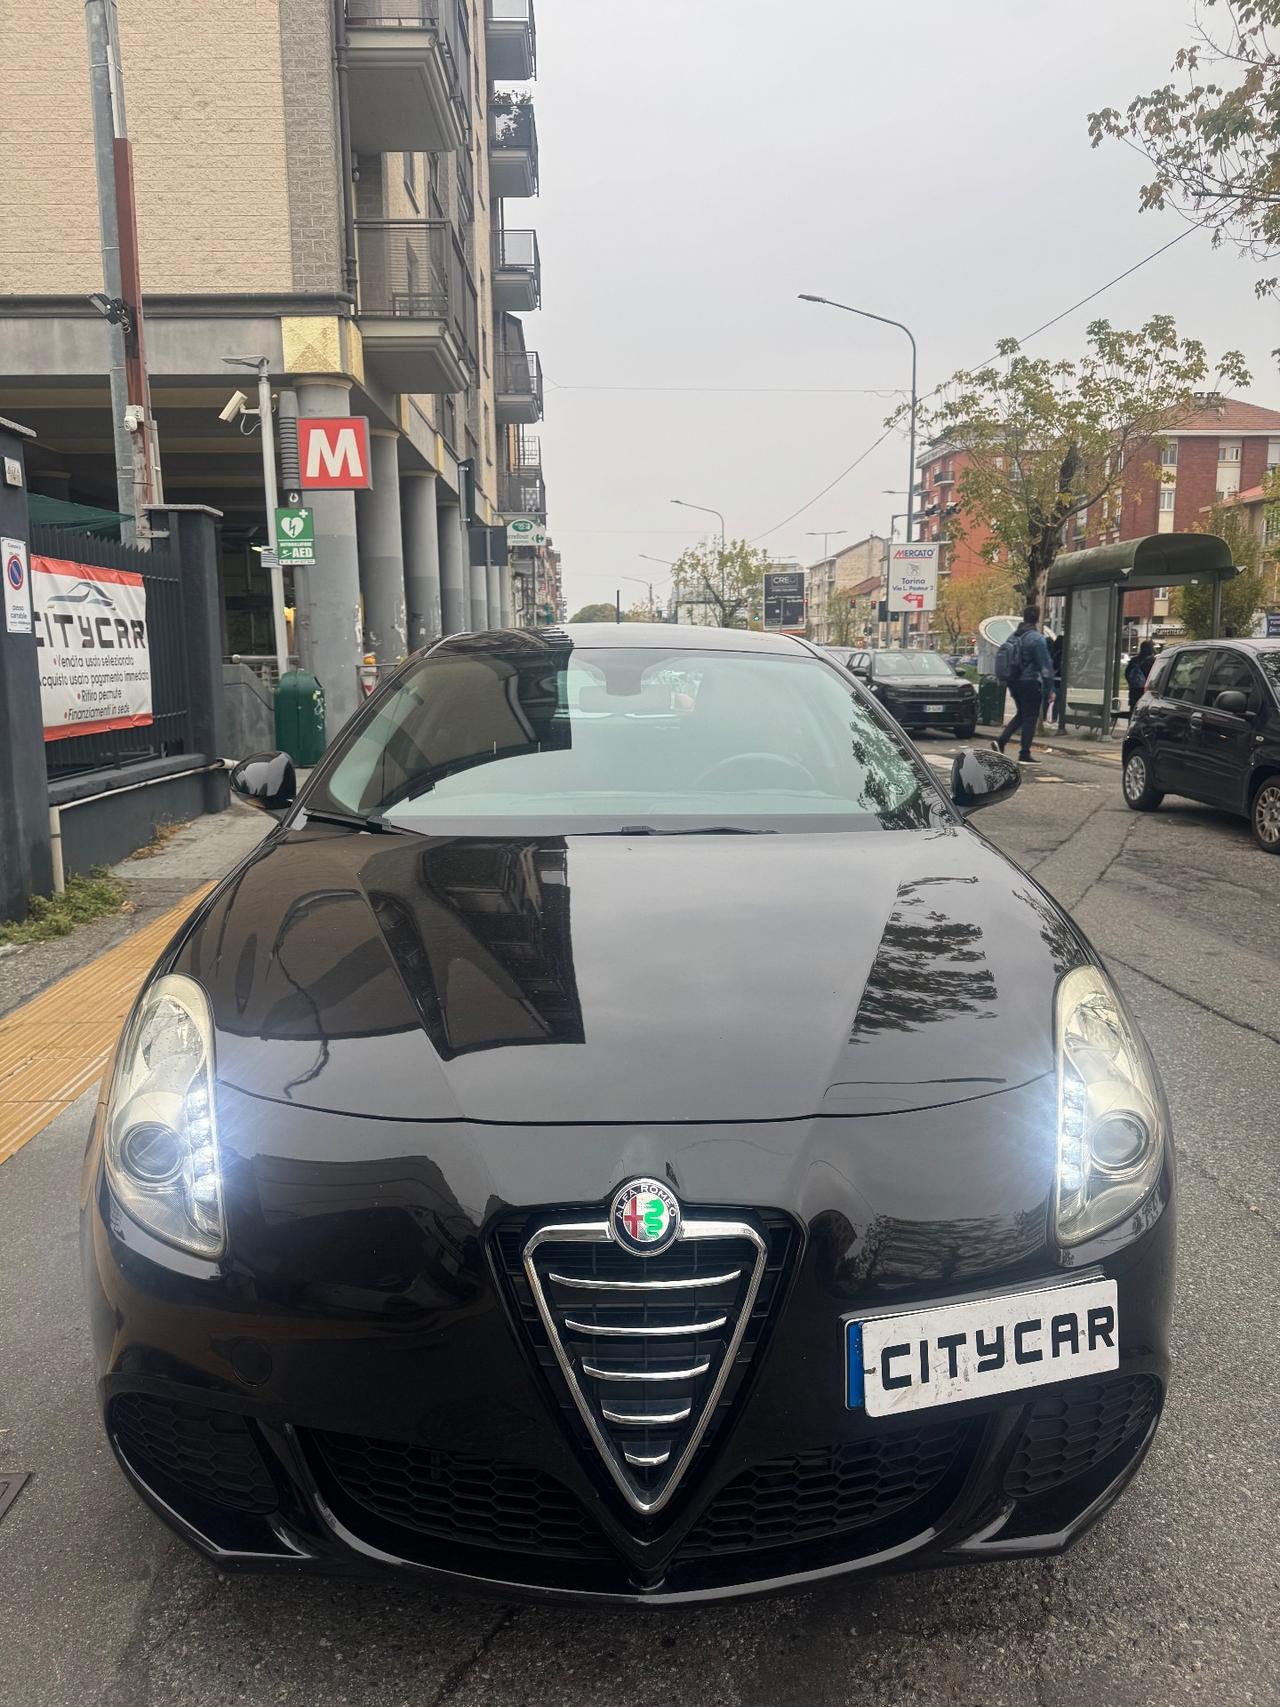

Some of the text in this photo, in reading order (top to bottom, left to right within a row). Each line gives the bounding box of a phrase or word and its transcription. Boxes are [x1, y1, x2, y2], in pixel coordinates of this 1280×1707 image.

[306, 428, 363, 477] M
[292, 547, 313, 558] AED
[57, 655, 134, 668] Vendita usato selezionato
[69, 673, 89, 686] usato
[91, 671, 123, 687] pagamento
[124, 670, 149, 682] immediato
[81, 689, 122, 702] Ritiro permute
[68, 702, 130, 720] Finanziamenti in sede
[616, 1185, 677, 1219] ALFA ROMEO
[881, 1305, 1116, 1391] CITYCAR
